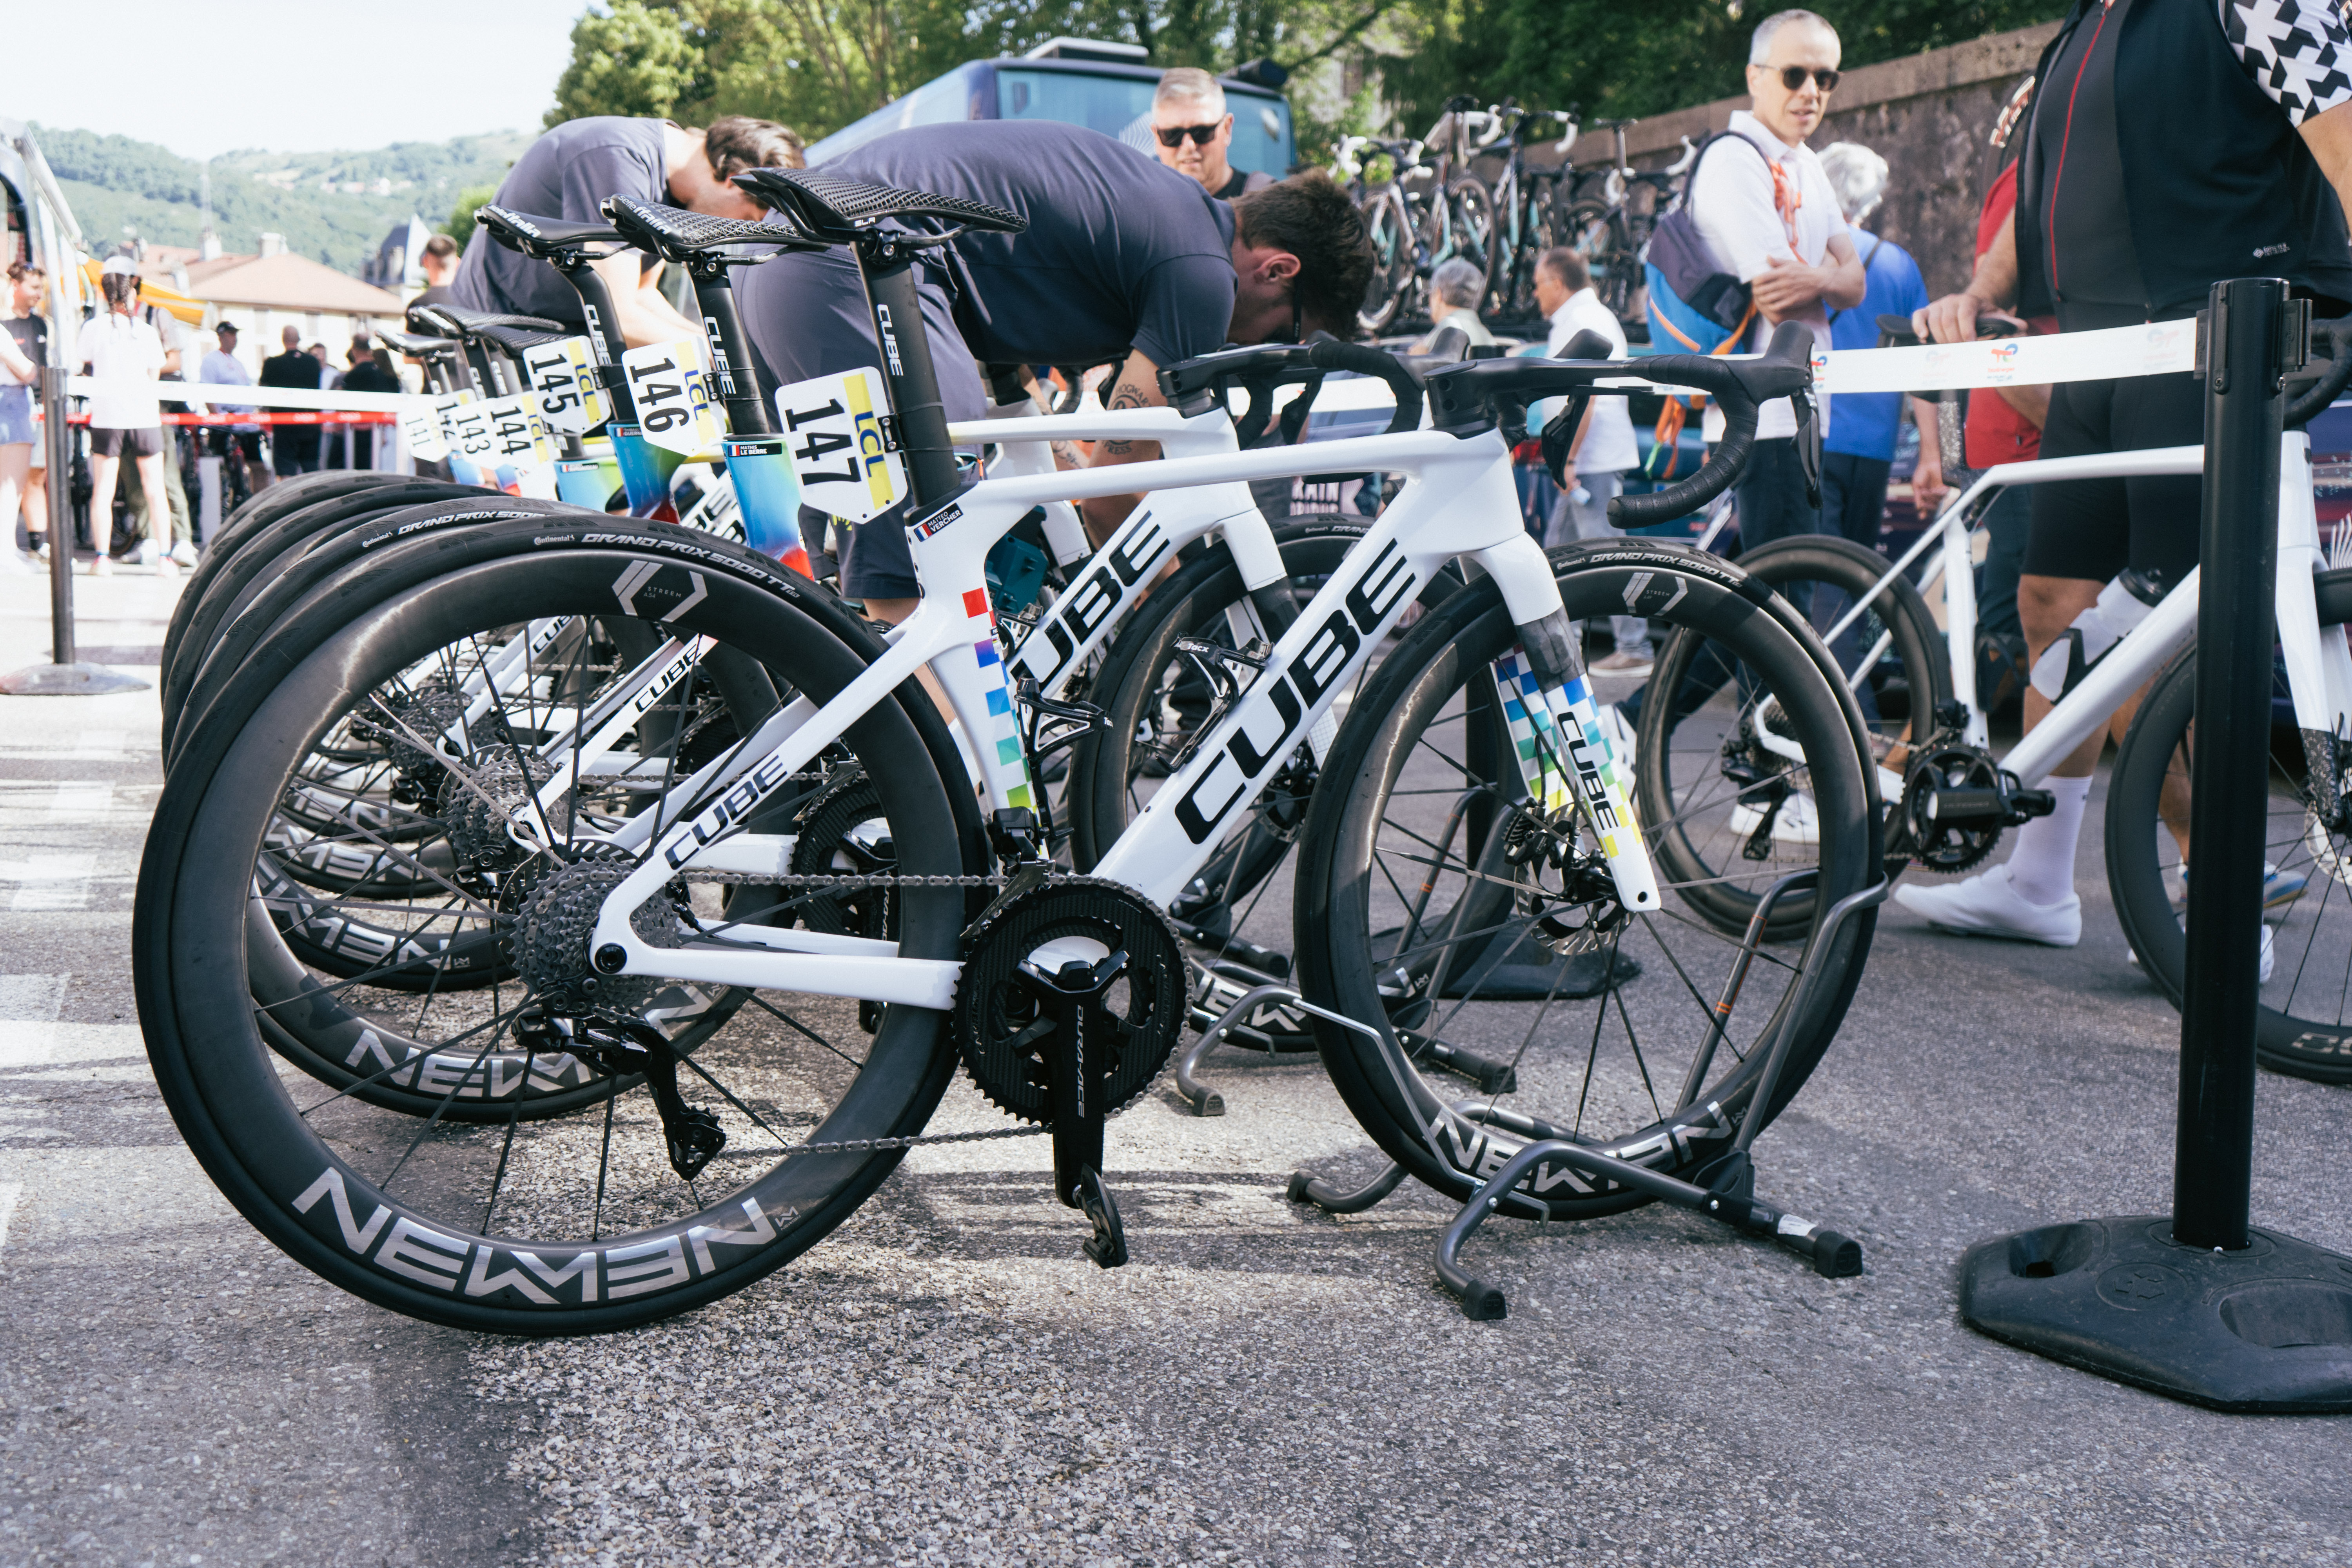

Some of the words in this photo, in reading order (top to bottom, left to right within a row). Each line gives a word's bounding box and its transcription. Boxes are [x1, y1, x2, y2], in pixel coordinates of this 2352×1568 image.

[854, 217, 876, 227] SLR
[585, 304, 612, 365] CUBE
[704, 316, 737, 394] CUBE
[877, 304, 904, 376] CUBE
[530, 354, 581, 414] 145
[575, 363, 595, 405] LCL
[630, 357, 690, 432] 146
[684, 370, 708, 421] LCL
[405, 418, 431, 447] 141
[456, 414, 490, 454] 143
[490, 406, 532, 455] 144
[528, 414, 543, 447] LCL
[785, 398, 862, 486] 147
[855, 410, 885, 478] LCL
[362, 533, 388, 547] Continental
[398, 515, 454, 535] GRAND
[454, 511, 497, 522] PRIX
[927, 511, 949, 527] MATTEO
[930, 509, 961, 533] VERCHER
[534, 535, 570, 545] Continental
[581, 534, 659, 546] GRAND
[657, 540, 711, 559] PRIX
[707, 552, 770, 579] 5000
[1557, 558, 1583, 570] Continental
[1589, 552, 1641, 563] GRAND
[1641, 554, 1682, 565] PRIX
[1677, 559, 1721, 576] 5000
[647, 586, 682, 598] STREEM
[1009, 510, 1171, 693] UBE
[532, 615, 573, 653] CUB
[1187, 643, 1210, 653] Tacx
[635, 644, 701, 713] CUBE
[1174, 537, 1416, 844] CUBE
[1557, 711, 1619, 831] CUBE
[664, 755, 788, 871] CUBE
[1077, 1005, 1085, 1118] DURA-ACE
[291, 1166, 777, 1304] NEWMEN
